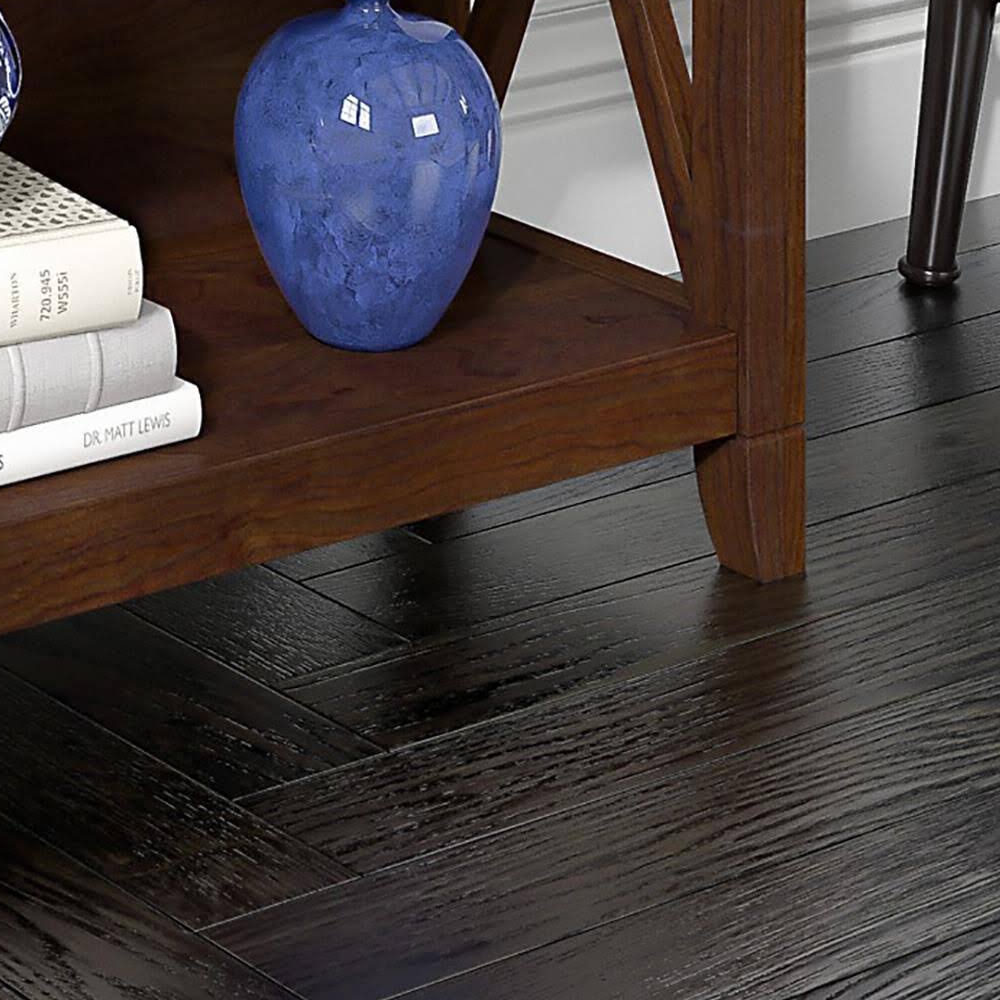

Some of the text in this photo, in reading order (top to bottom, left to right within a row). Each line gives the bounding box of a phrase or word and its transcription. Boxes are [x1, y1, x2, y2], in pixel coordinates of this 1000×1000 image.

[9, 271, 20, 329] WHARTON
[39, 268, 53, 322] 720.945
[55, 270, 70, 315] W555i
[82, 429, 102, 449] DR.
[103, 420, 136, 444] MATT
[137, 411, 172, 436] LEWIS
